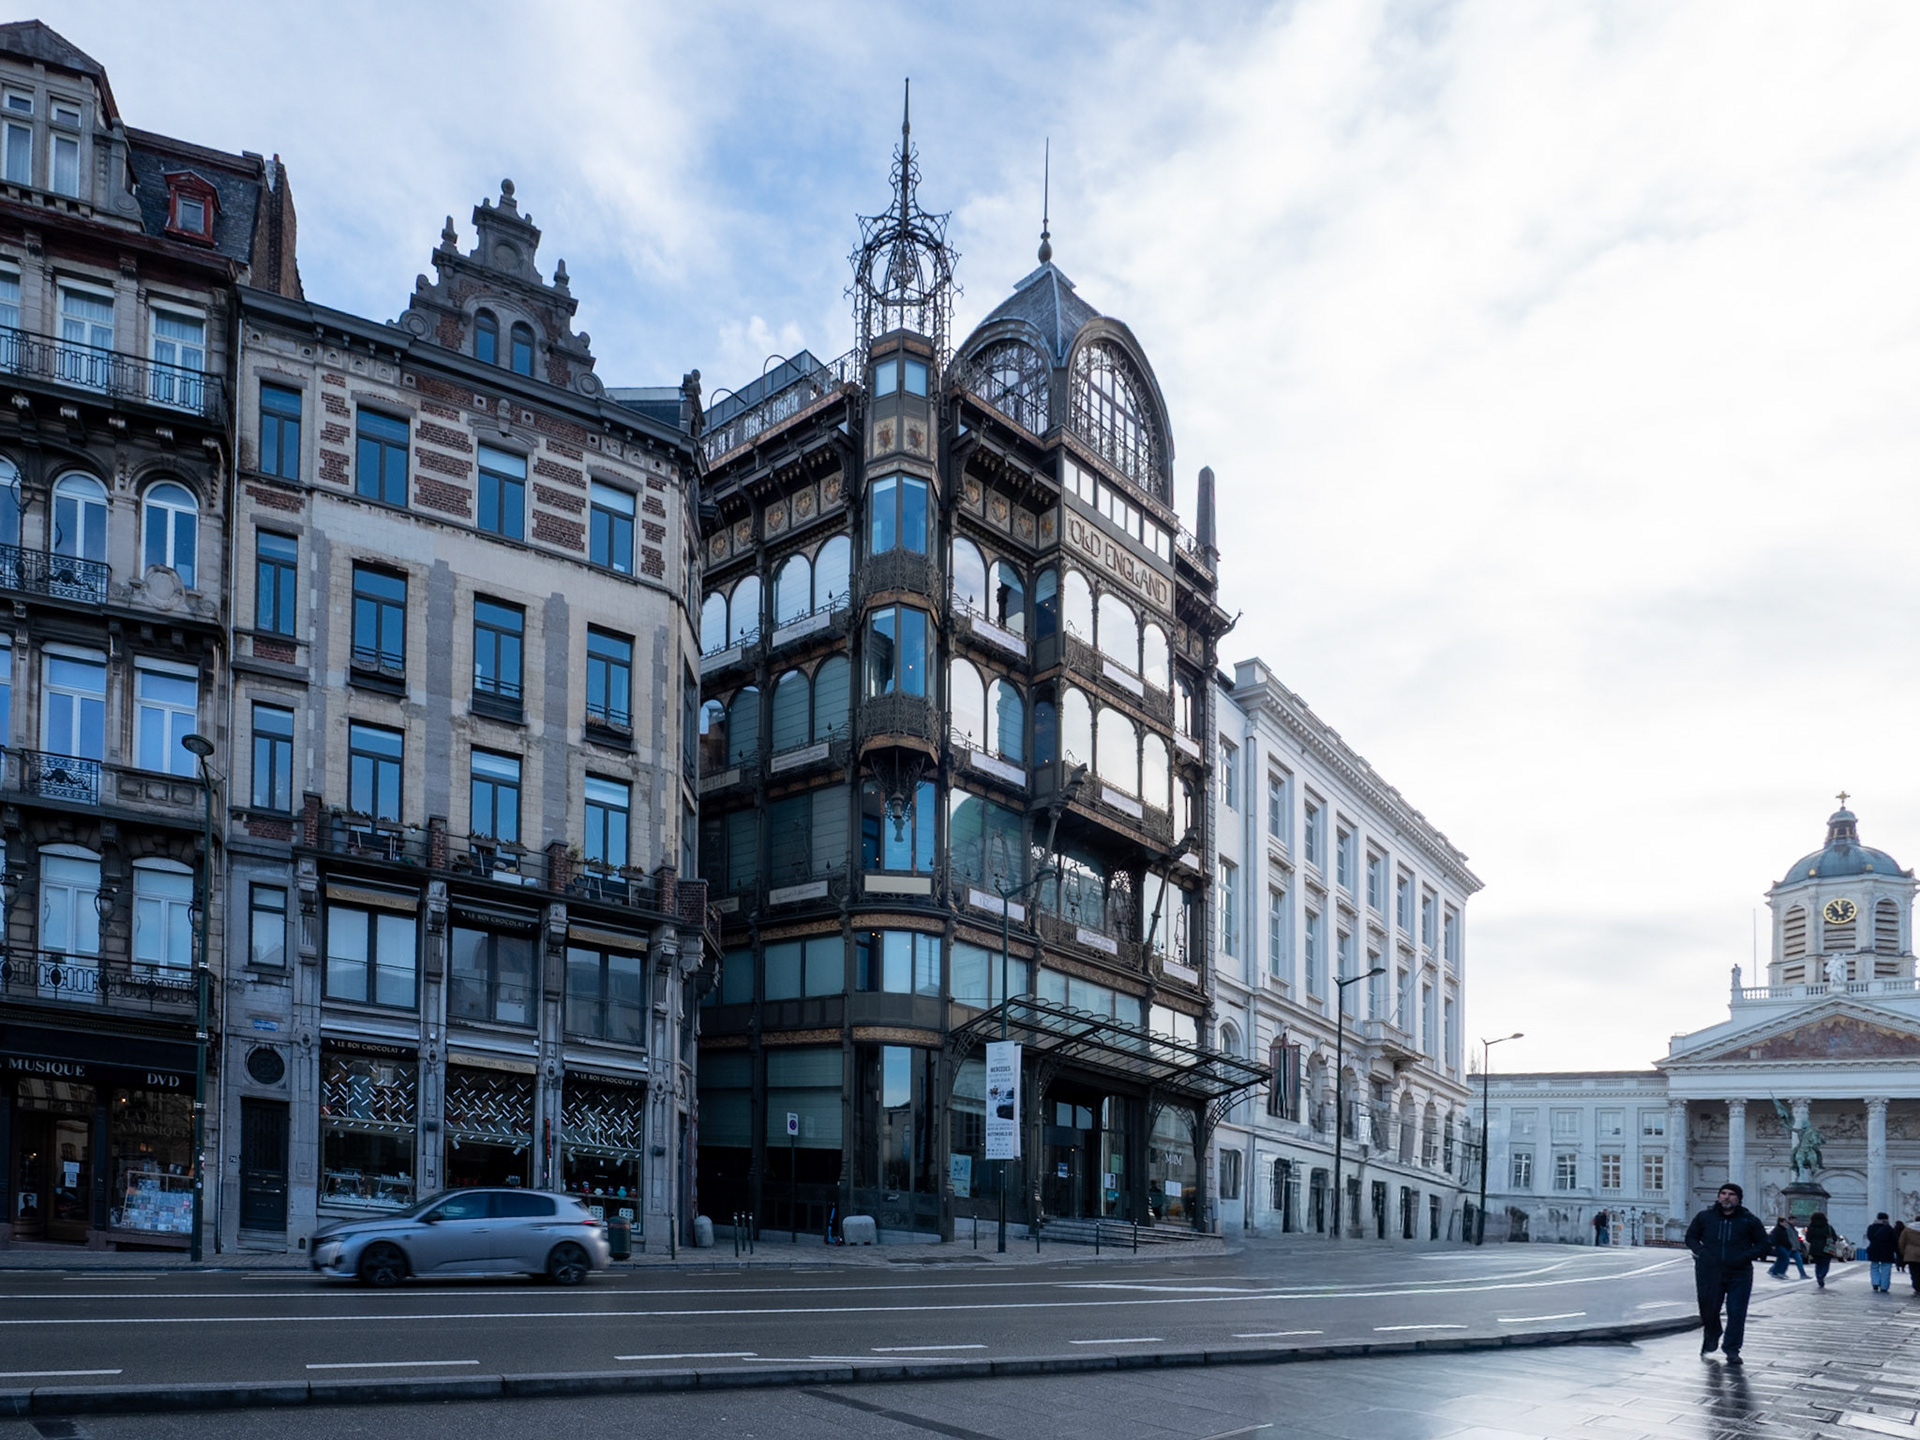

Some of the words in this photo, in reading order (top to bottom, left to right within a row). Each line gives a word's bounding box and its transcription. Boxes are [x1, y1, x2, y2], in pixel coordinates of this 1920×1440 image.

[1070, 519, 1101, 558] OLD
[1105, 541, 1168, 605] ENGLAND
[490, 917, 526, 928] CHOCOLAT
[337, 1040, 346, 1048] LE
[347, 1042, 360, 1050] ROI
[361, 1043, 399, 1054] CHOCOLAT
[8, 1057, 86, 1078] MUSIQUE
[147, 1072, 181, 1088] DVD
[588, 1074, 600, 1082] ROI
[600, 1075, 634, 1086] CHOCOLAT
